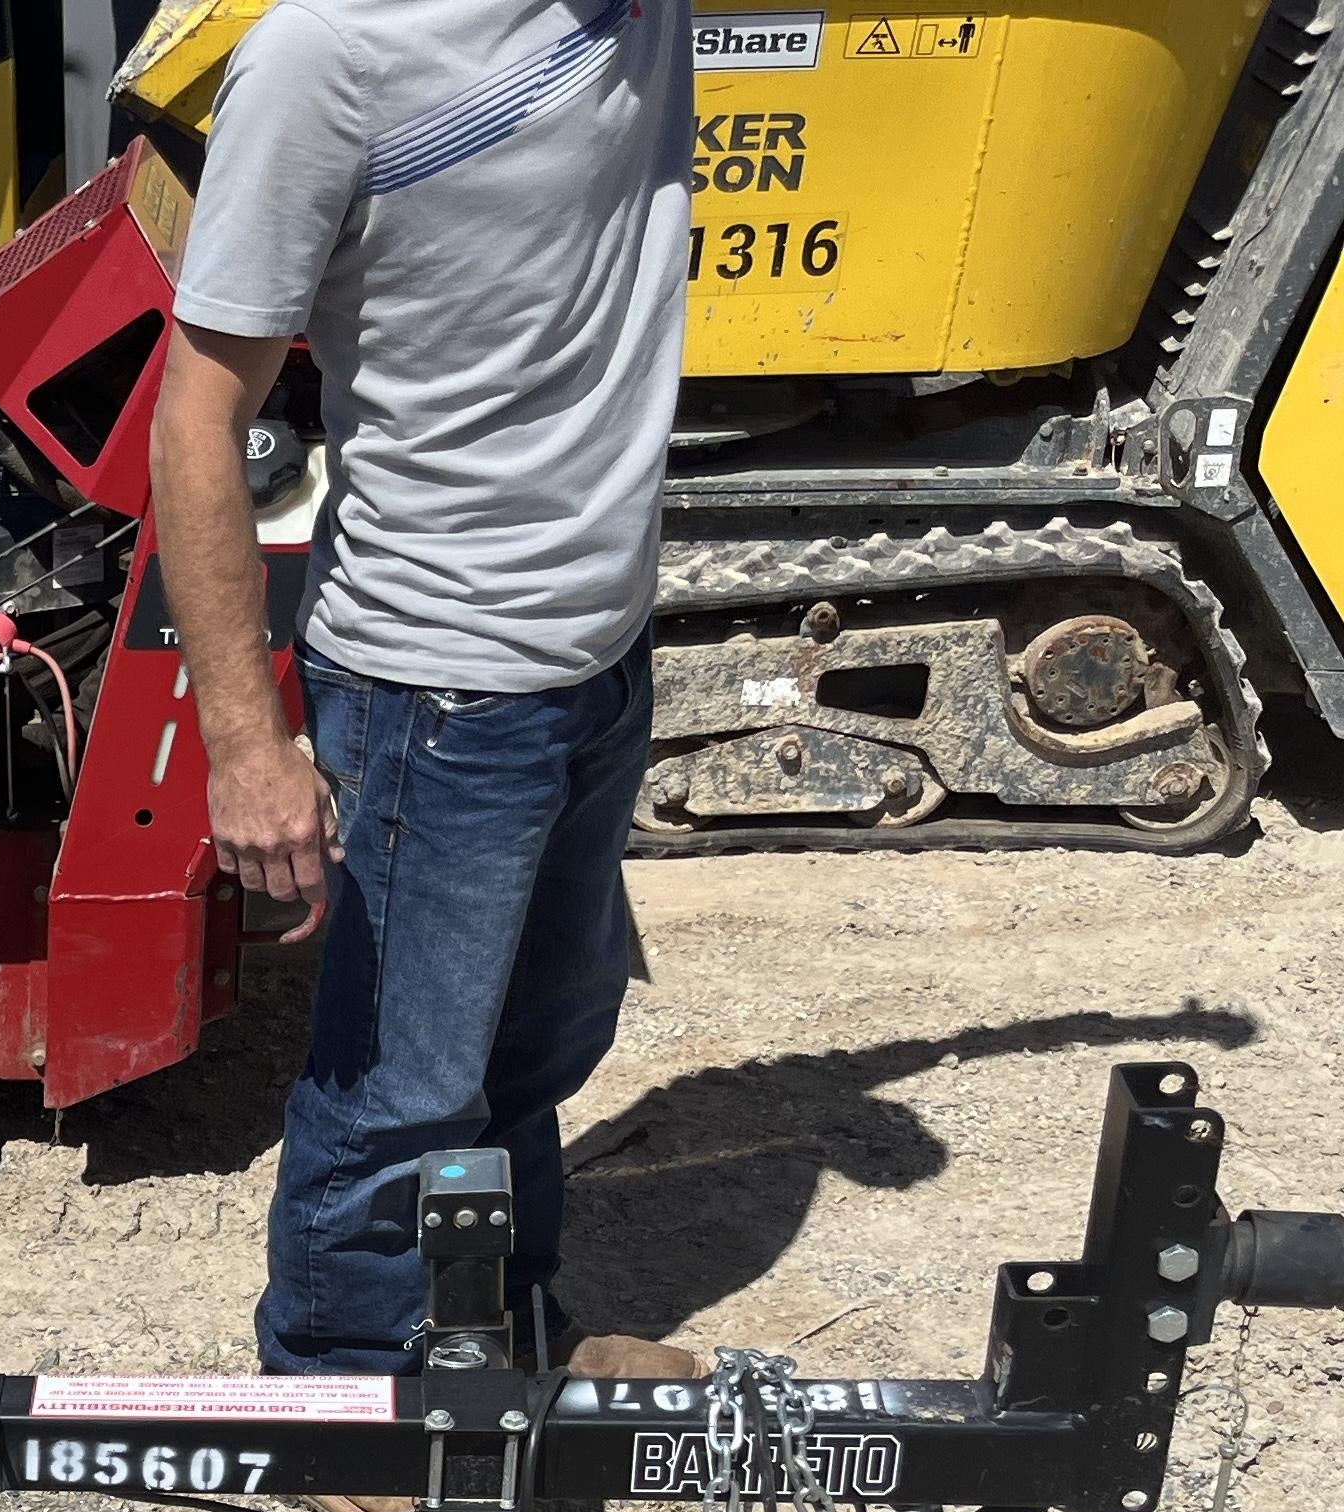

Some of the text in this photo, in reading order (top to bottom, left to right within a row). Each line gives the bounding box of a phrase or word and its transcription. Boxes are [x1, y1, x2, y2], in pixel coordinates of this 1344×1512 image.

[692, 28, 808, 55] Share
[36, 1402, 196, 1412] RESPONSIBILITY
[200, 1404, 307, 1414] CUSTOMER
[607, 1382, 878, 1412] 18507
[24, 1438, 271, 1494] 185607
